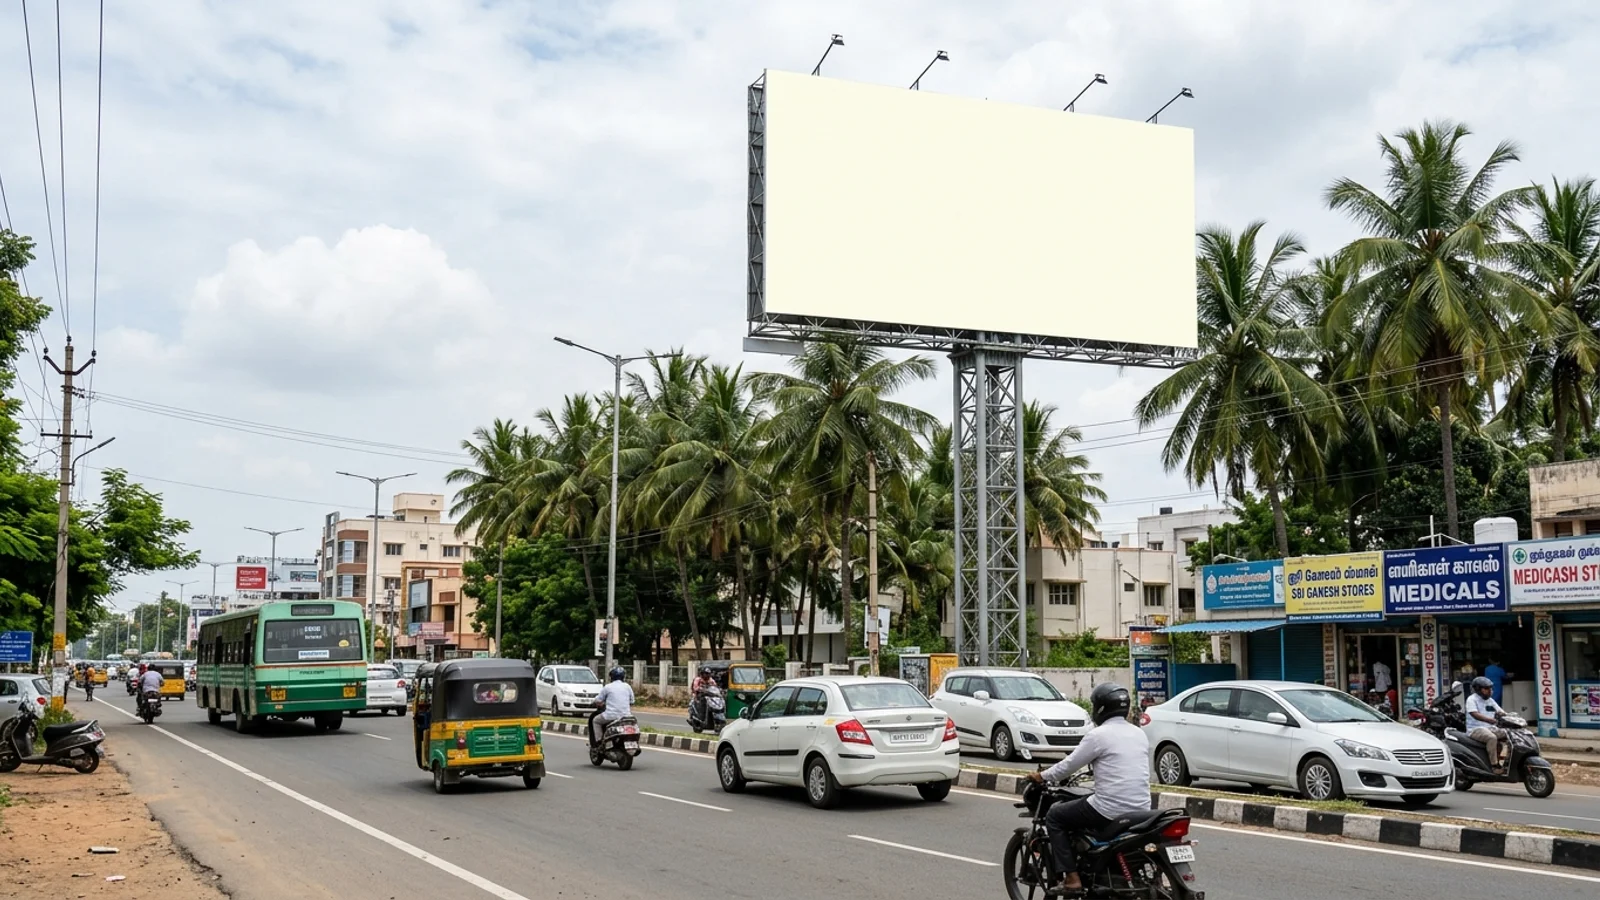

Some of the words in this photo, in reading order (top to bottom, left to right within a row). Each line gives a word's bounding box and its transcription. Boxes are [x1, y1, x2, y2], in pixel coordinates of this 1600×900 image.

[1514, 566, 1578, 585] MEDICASH
[1582, 564, 1600, 582] ST
[1342, 583, 1375, 597] STORES
[1389, 580, 1500, 603] MEDICALS
